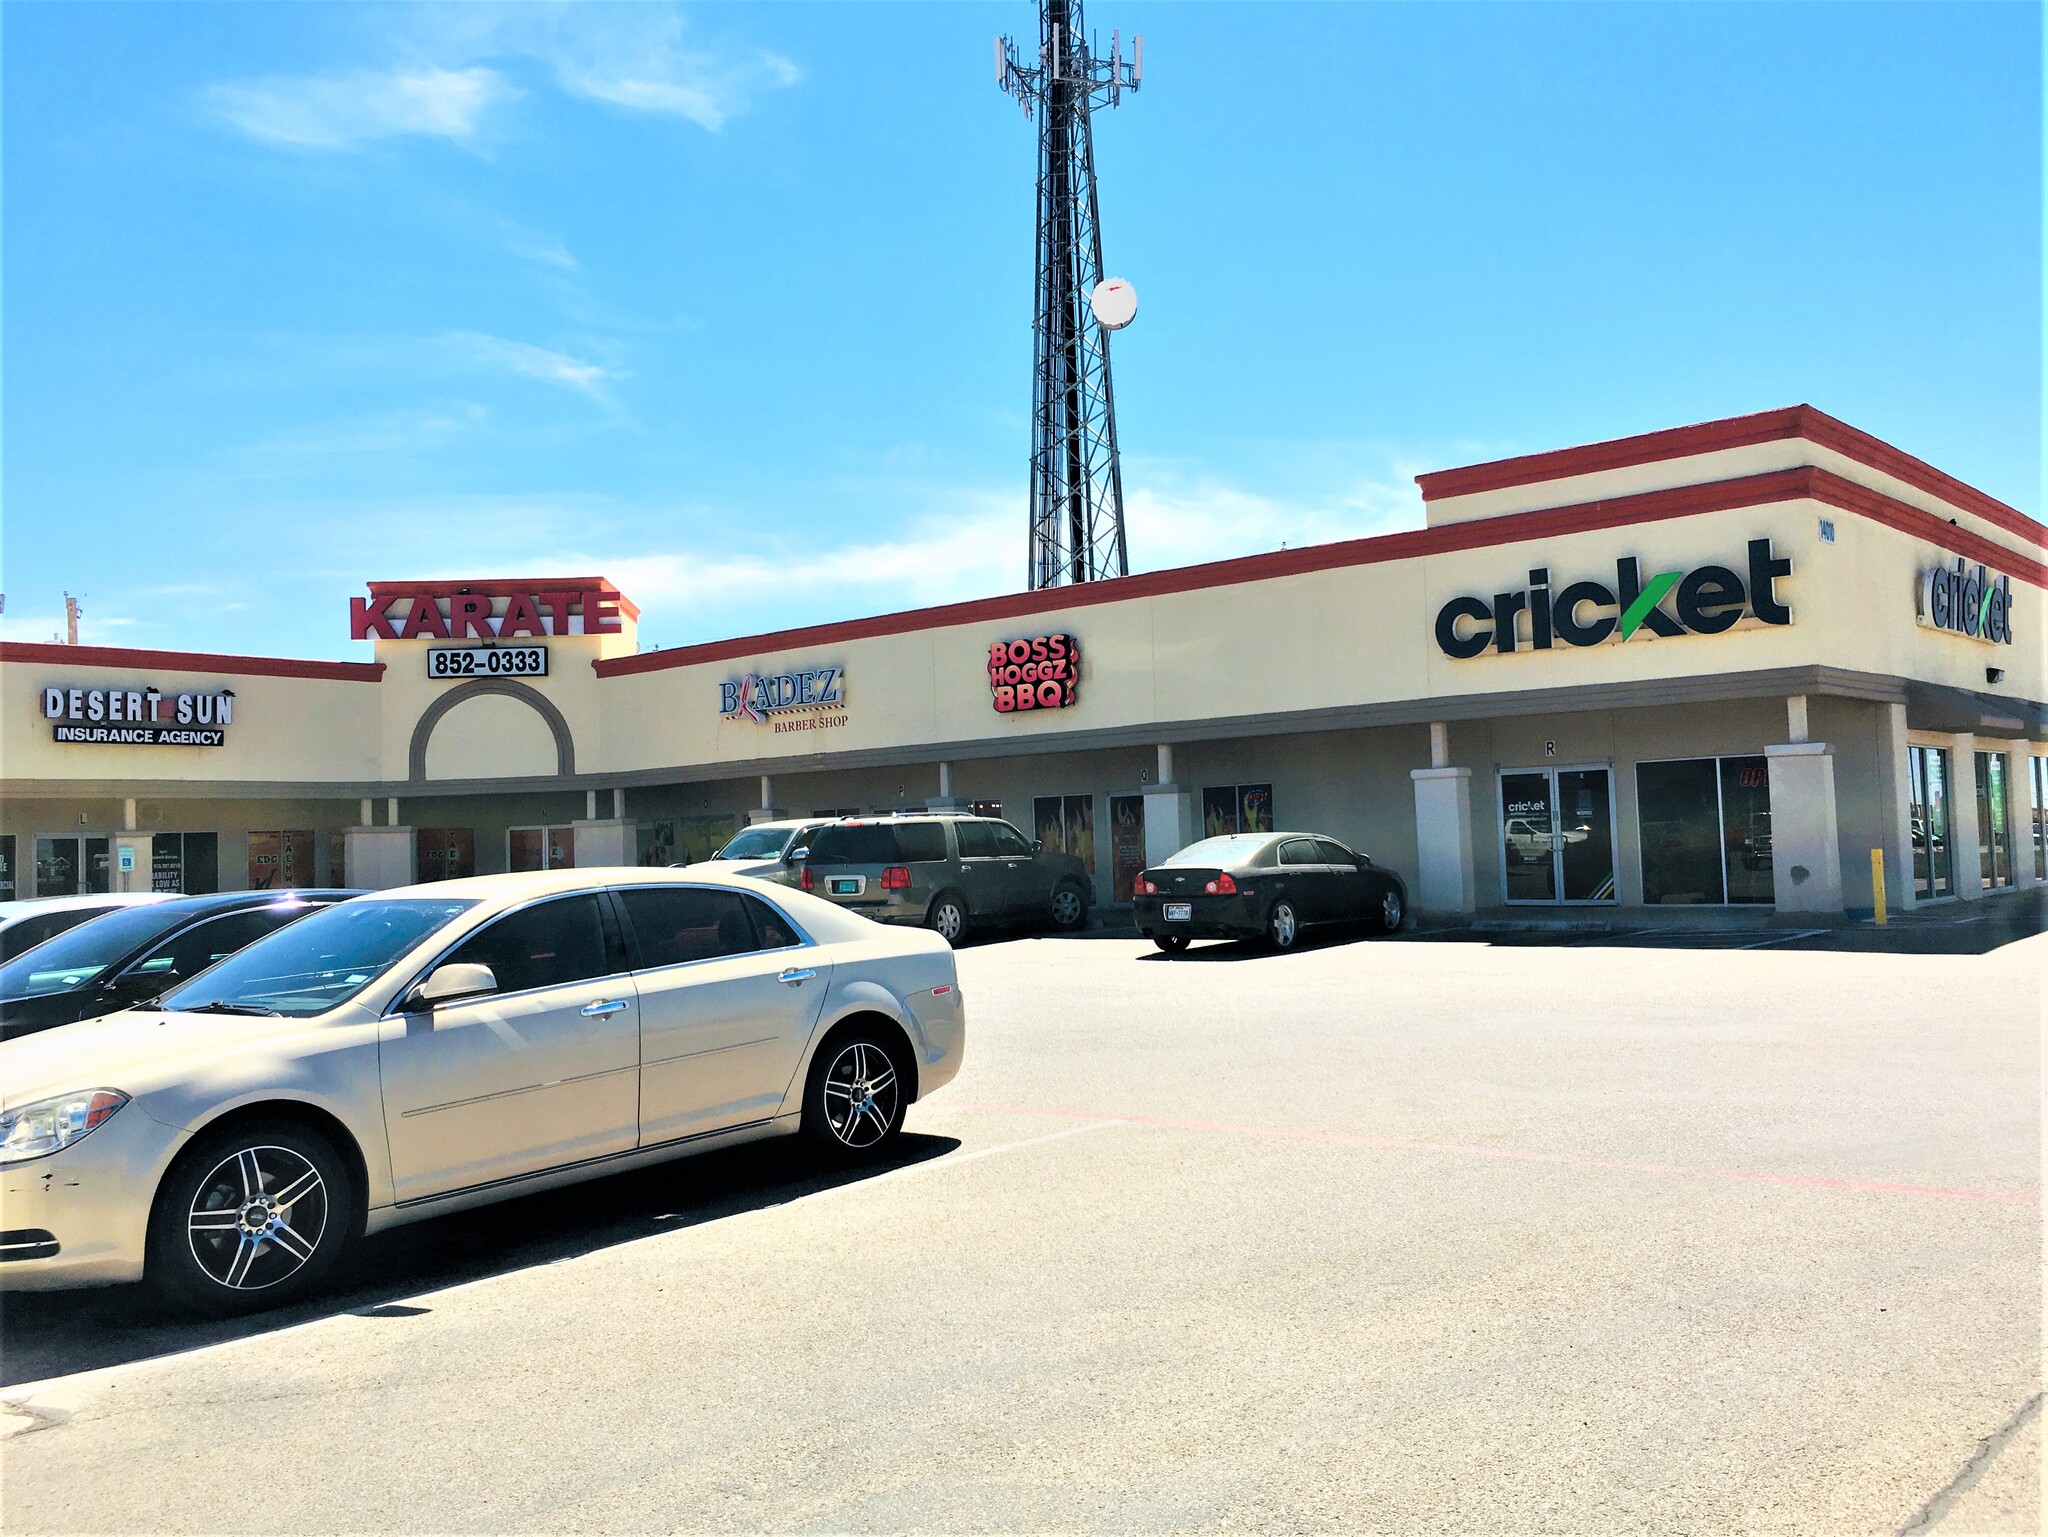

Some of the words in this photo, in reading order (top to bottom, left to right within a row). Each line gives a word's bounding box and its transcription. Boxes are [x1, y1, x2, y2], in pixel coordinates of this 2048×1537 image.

[1435, 538, 1792, 659] cricket
[1931, 557, 2013, 645] cricket
[350, 591, 623, 640] KARATE
[434, 650, 541, 674] 852-0333
[990, 634, 1066, 667] BOSS
[991, 659, 1067, 687] HOGGZ
[44, 688, 161, 722] DESERT
[176, 694, 233, 725] SUN
[719, 668, 842, 724] BLADEZ
[997, 680, 1062, 712] BBQ
[57, 727, 154, 743] INSURANCE
[158, 730, 222, 745] AGENCY
[774, 718, 817, 733] BARBER
[819, 715, 848, 729] SHOP
[1546, 741, 1555, 755] R
[1141, 769, 1148, 781] Q
[80, 814, 85, 824] L
[284, 835, 293, 888] TAEKW
